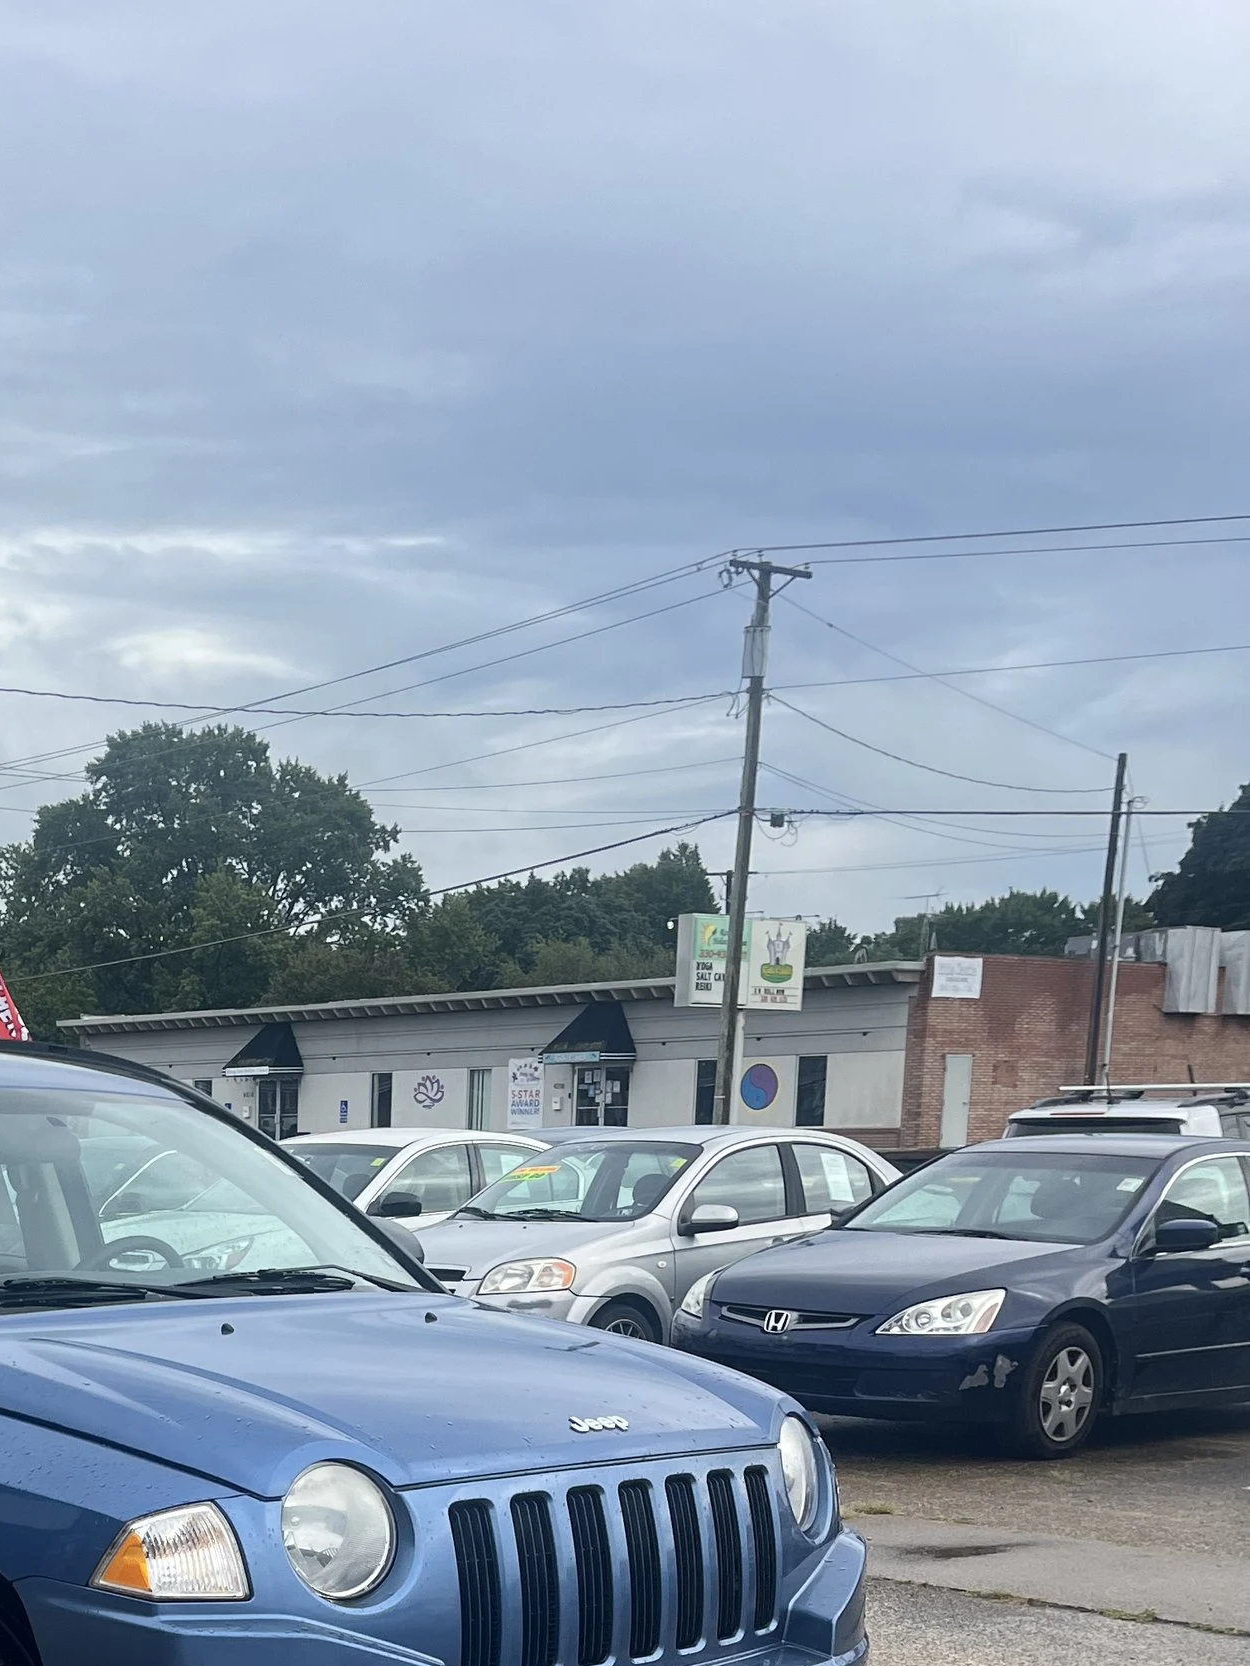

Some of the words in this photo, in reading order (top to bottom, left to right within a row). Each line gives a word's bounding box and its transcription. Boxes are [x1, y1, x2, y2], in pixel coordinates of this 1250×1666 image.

[696, 961, 713, 970] YOGA
[696, 972, 712, 981] SALT
[695, 982, 712, 991] REIKI
[511, 1090, 540, 1099] 5-STAR
[511, 1099, 540, 1107] AWARD
[568, 1415, 629, 1433] Jeep
